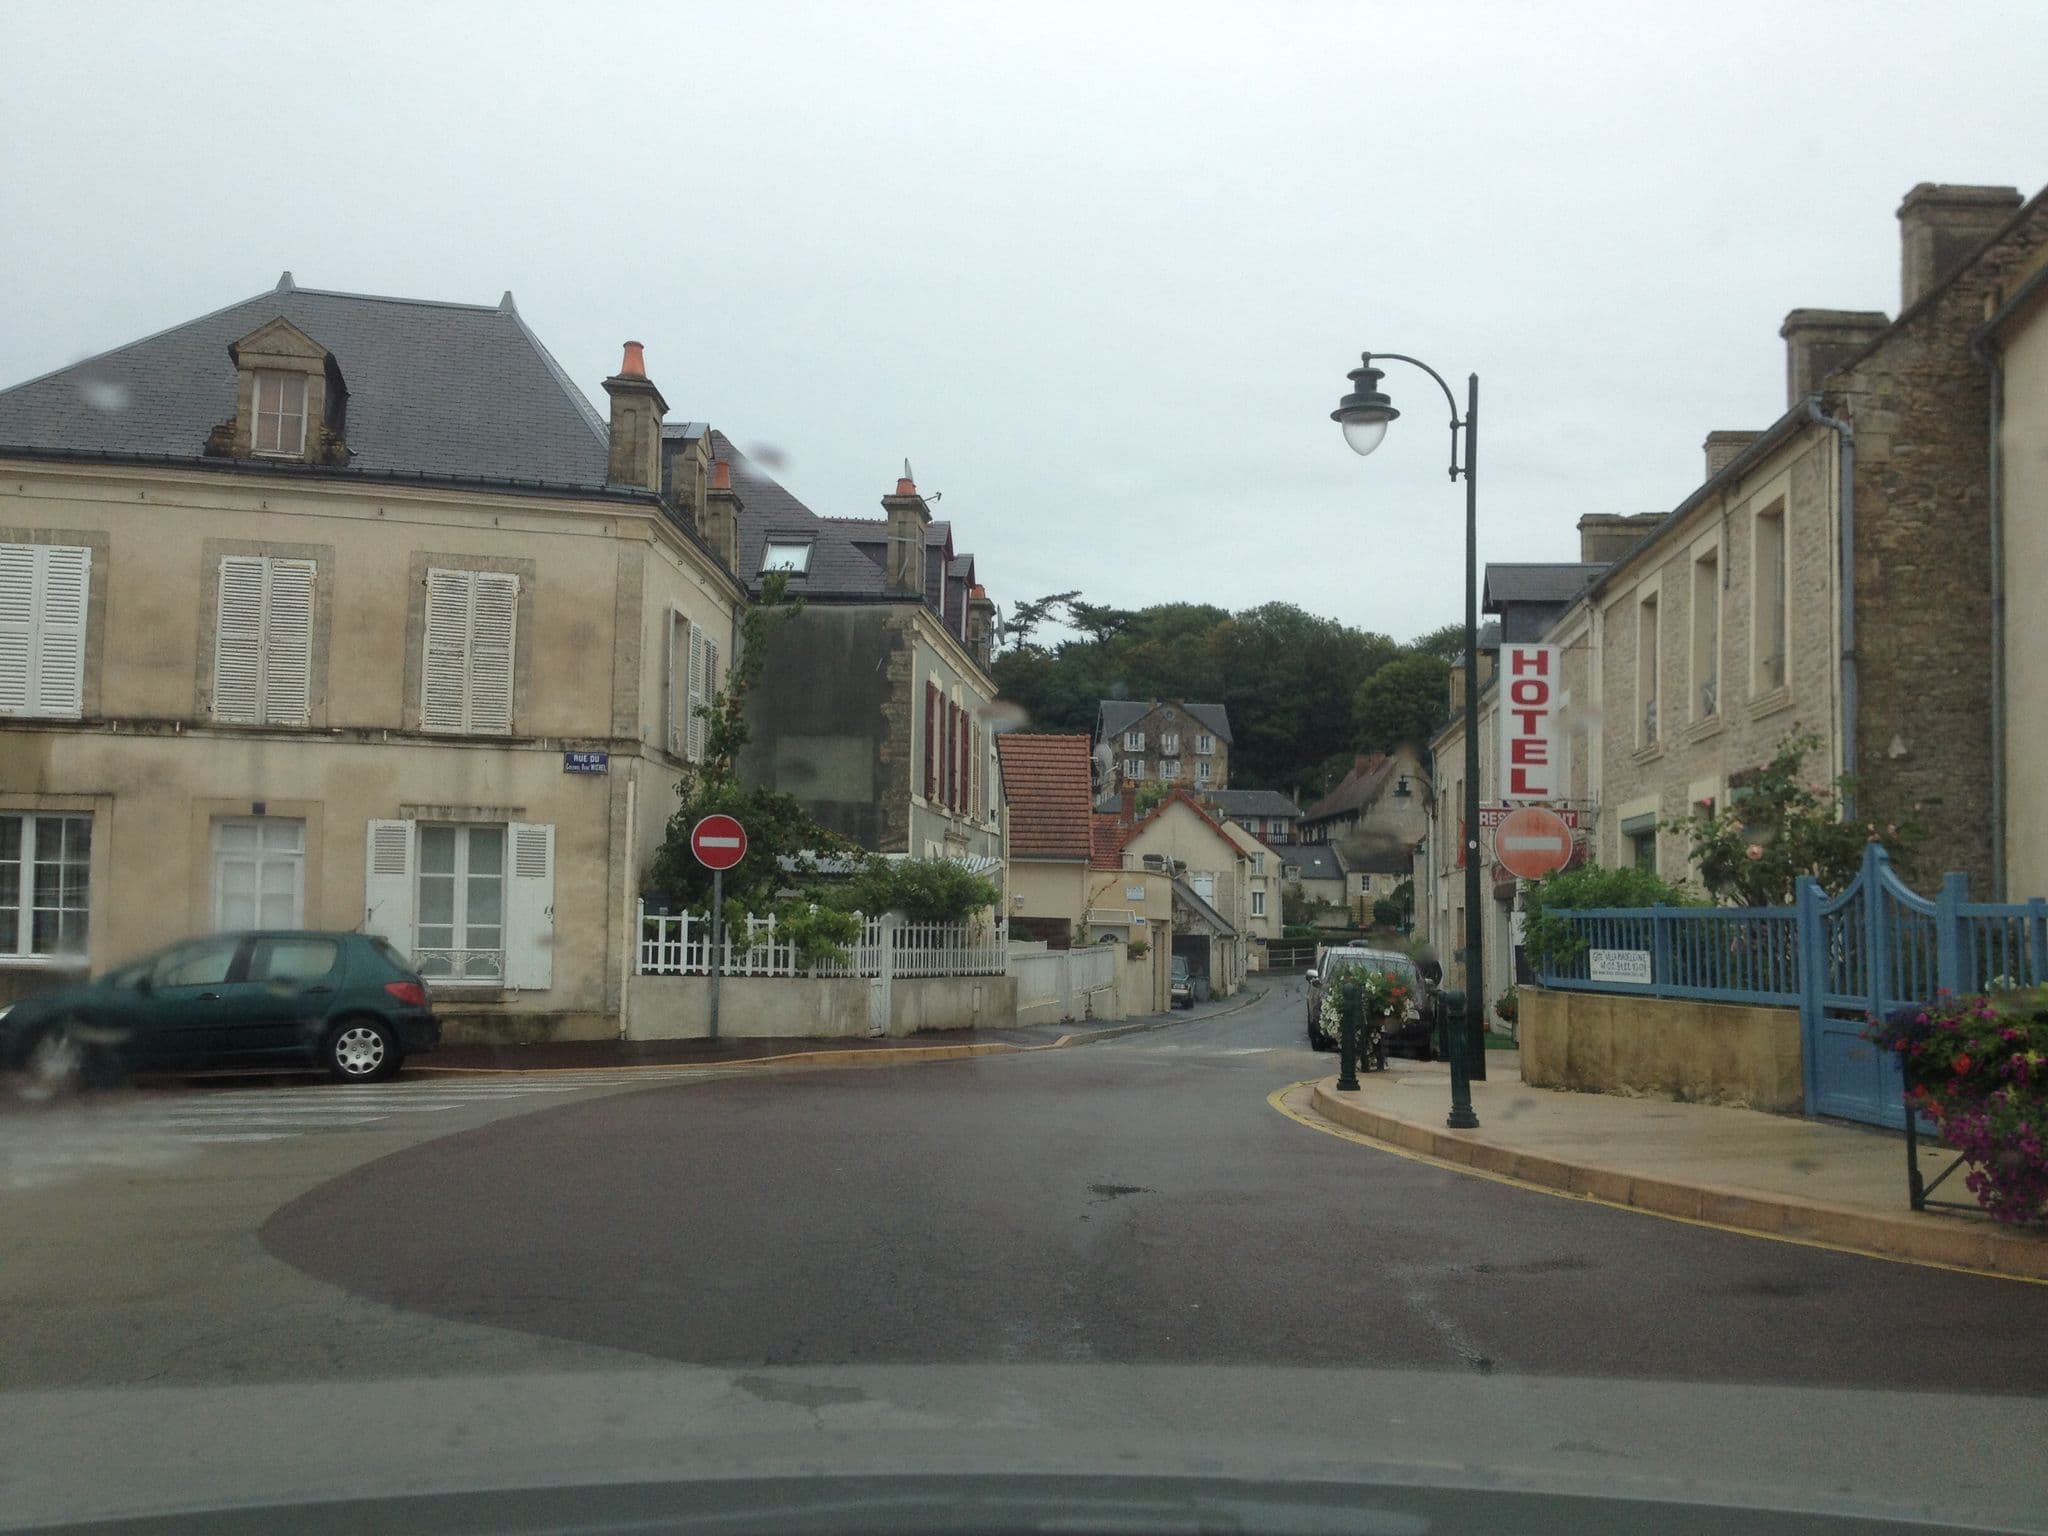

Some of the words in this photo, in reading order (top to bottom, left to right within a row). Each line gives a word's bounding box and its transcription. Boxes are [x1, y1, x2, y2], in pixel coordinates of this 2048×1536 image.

[573, 754, 588, 762] RUE
[590, 755, 600, 763] DU
[1510, 649, 1549, 795] HOTEL
